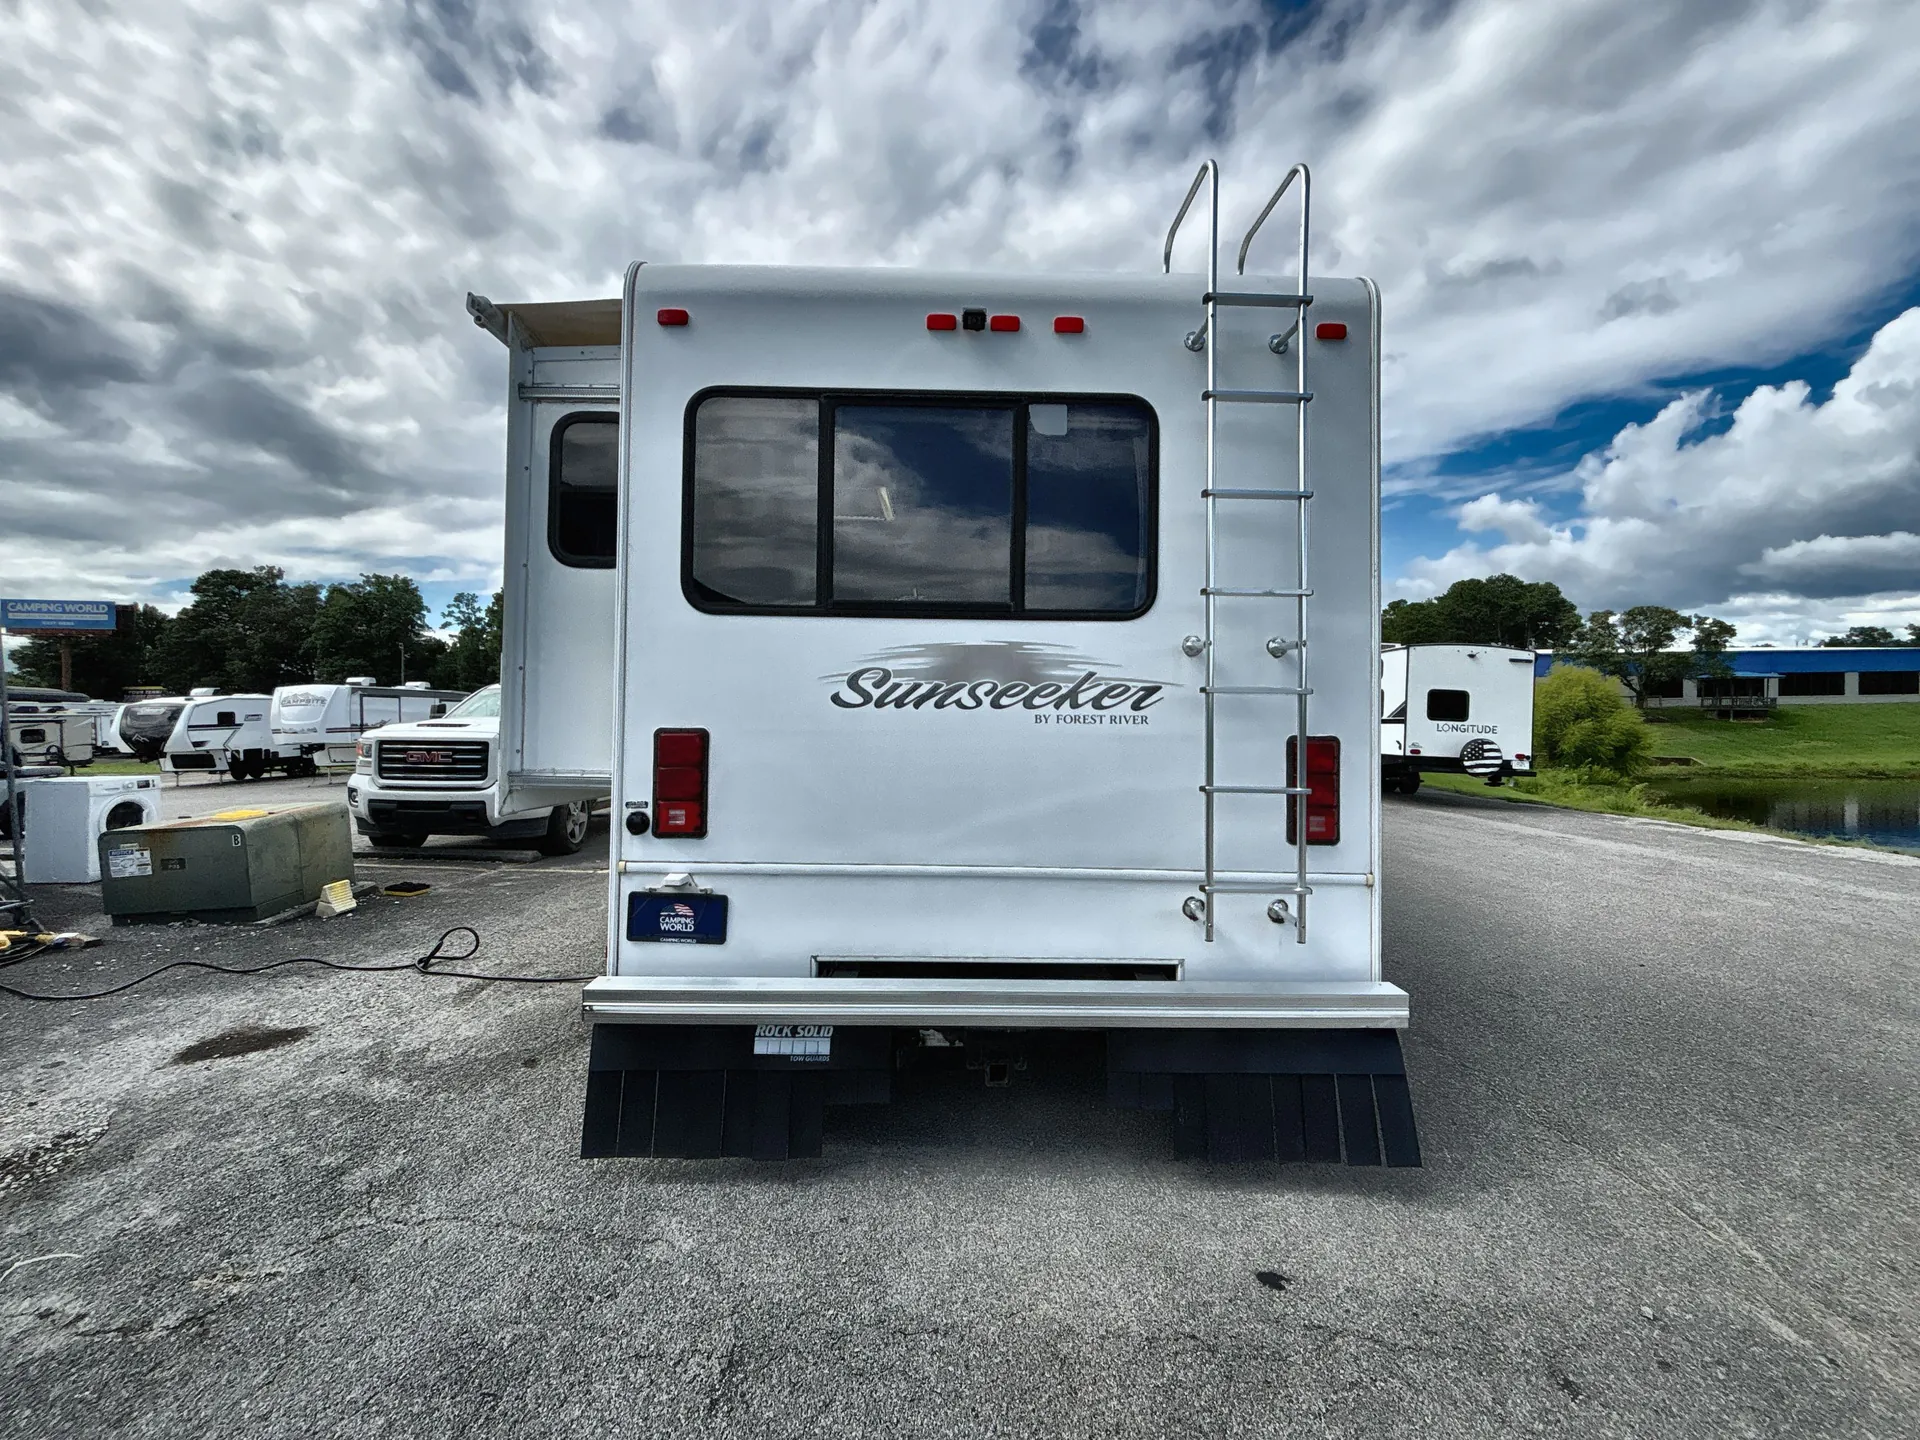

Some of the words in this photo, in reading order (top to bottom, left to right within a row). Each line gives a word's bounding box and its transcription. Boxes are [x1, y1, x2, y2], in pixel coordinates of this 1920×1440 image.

[7, 602, 62, 612] CAMPING
[64, 603, 108, 613] WORLD
[831, 667, 1164, 711] Sunseeker
[1034, 714, 1051, 724] BY
[1056, 714, 1106, 725] FOREST
[1109, 715, 1149, 725] RIVER
[1436, 723, 1498, 734] LONGITUDE
[406, 751, 453, 763] GMC
[233, 835, 240, 846] B
[659, 916, 695, 924] CAMPING
[660, 923, 695, 932] WORLD
[755, 1024, 793, 1037] ROCK
[795, 1025, 834, 1038] SOLID
[805, 1055, 831, 1063] GUARDS
